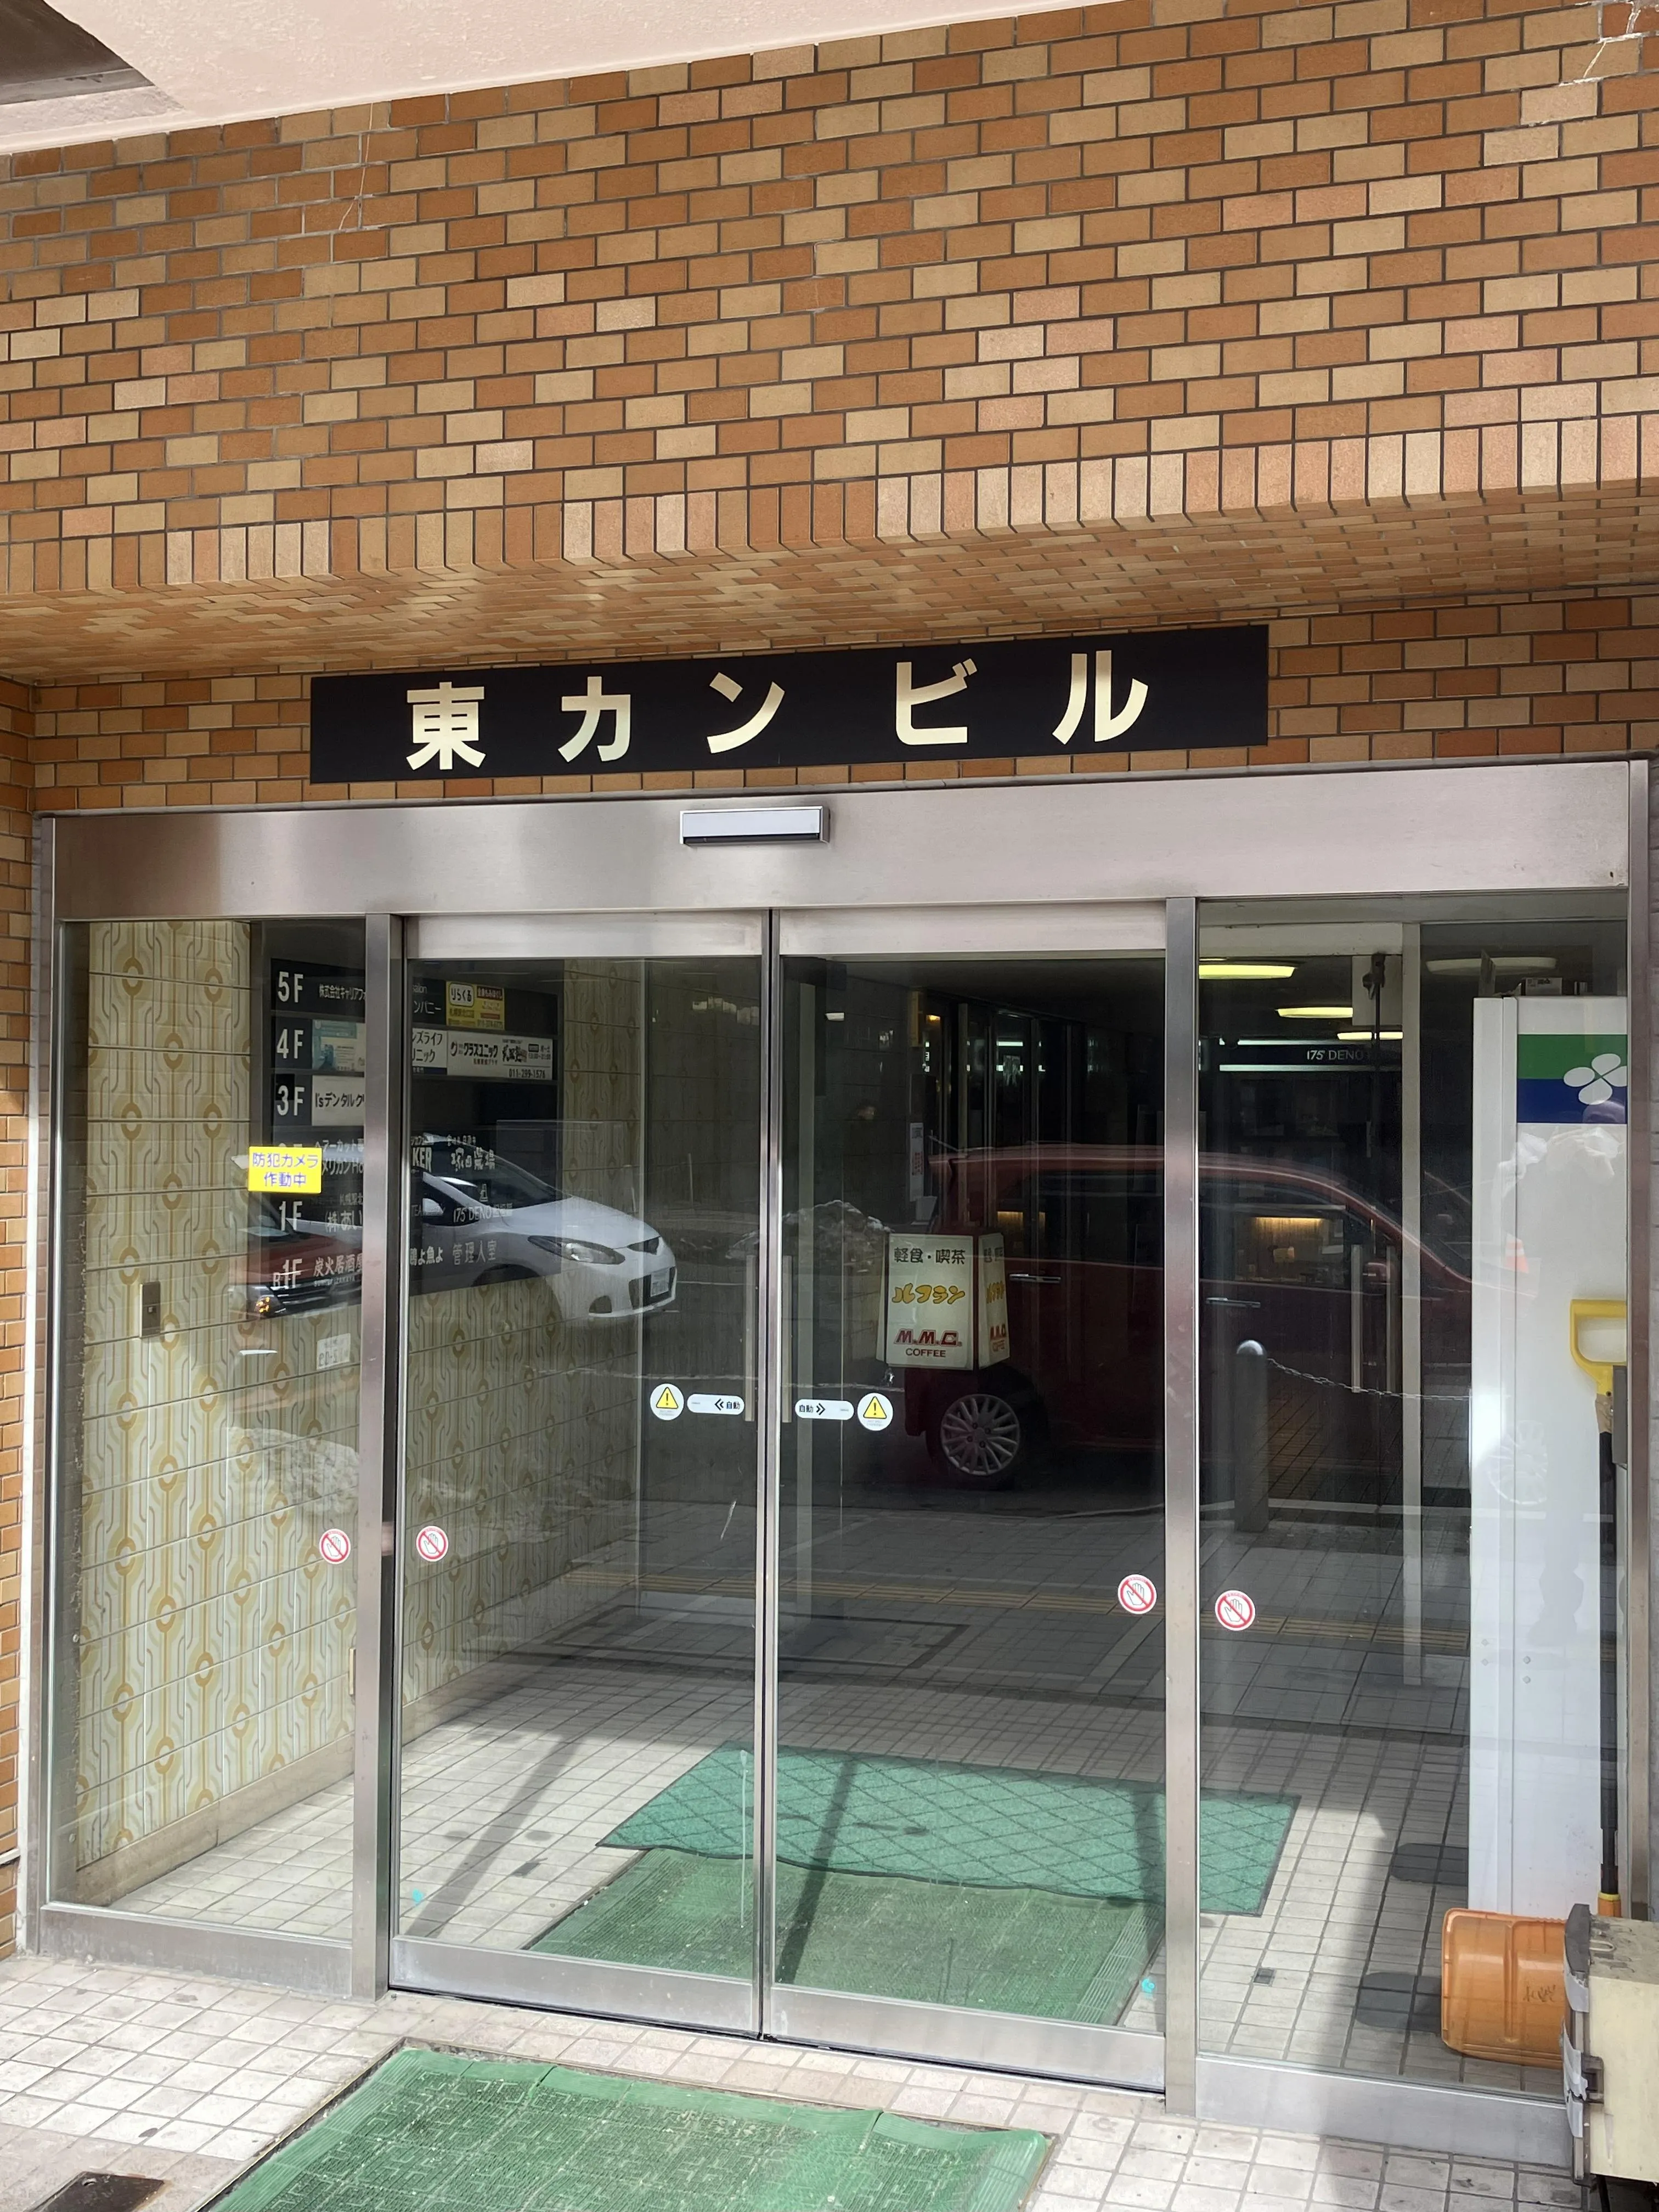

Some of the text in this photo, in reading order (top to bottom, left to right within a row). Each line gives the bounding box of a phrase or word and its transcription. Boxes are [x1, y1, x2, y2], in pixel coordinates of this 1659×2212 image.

[407, 650, 1148, 770] 東カンビル
[278, 971, 303, 1003] 5F
[451, 988, 472, 1002] りらくる
[276, 1029, 303, 1059] 4F
[277, 1085, 304, 1116] 3F
[252, 1153, 318, 1168] 防犯カメラ
[264, 1171, 307, 1188] 作動中
[279, 1201, 302, 1232] 1F
[453, 1239, 497, 1265] 管理人室
[894, 1247, 966, 1265] 軽食・喫茶
[891, 1283, 966, 1305] ルフラン
[906, 1348, 946, 1358] COFFEE
[726, 1401, 741, 1410] 自動
[799, 1404, 814, 1413] 自動
